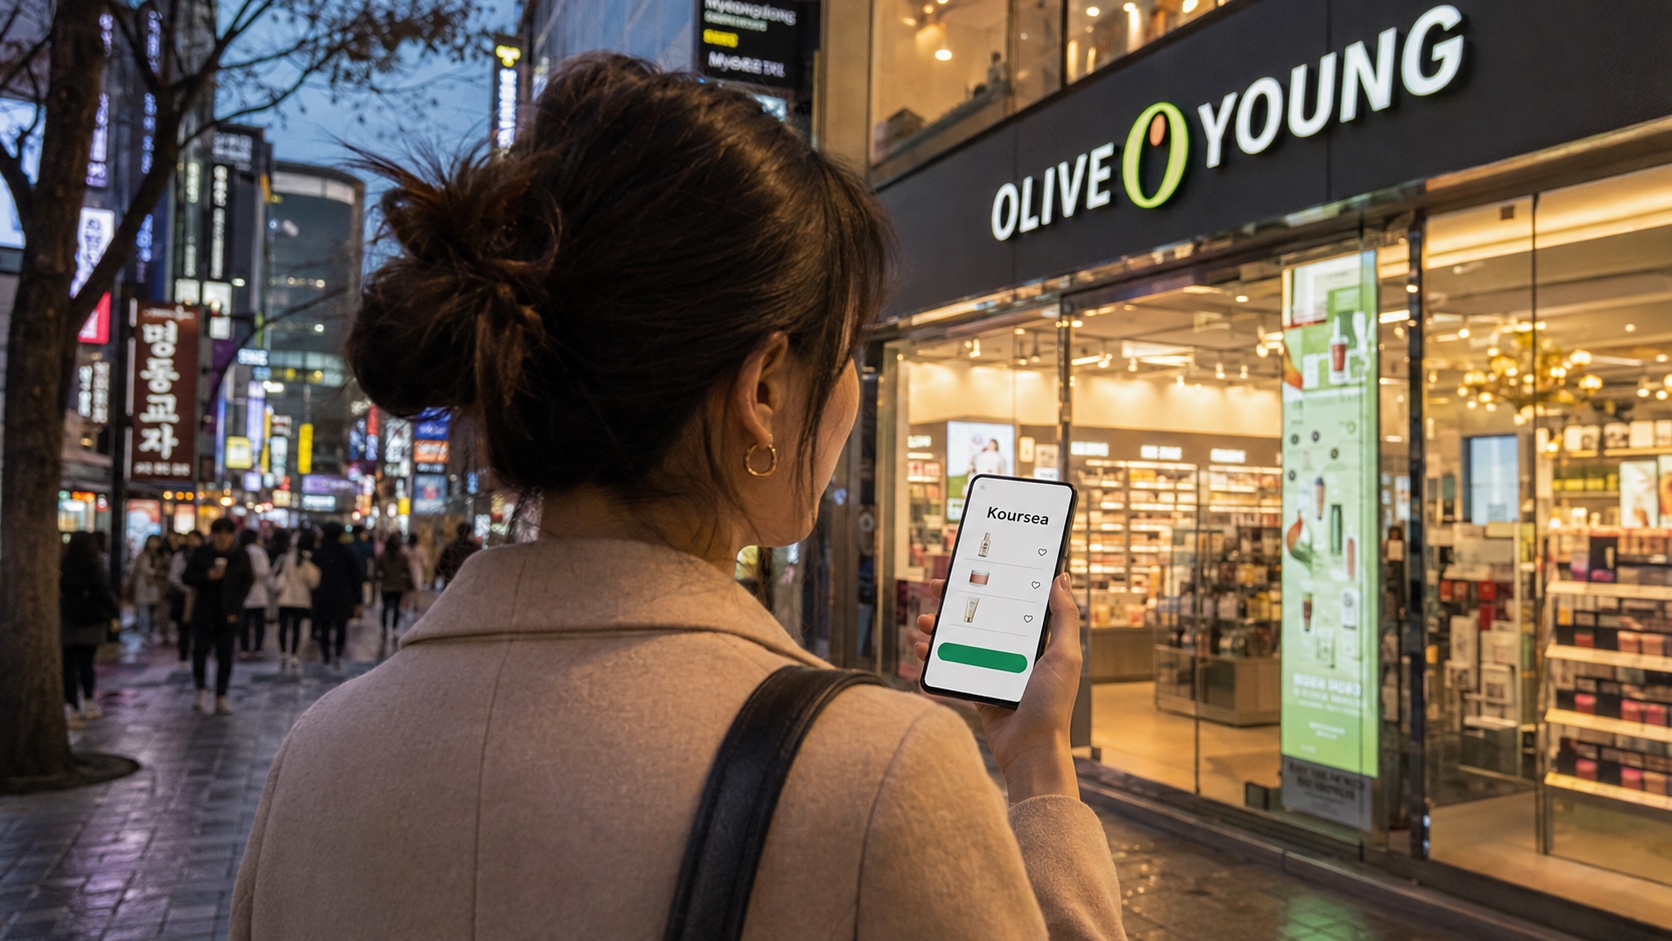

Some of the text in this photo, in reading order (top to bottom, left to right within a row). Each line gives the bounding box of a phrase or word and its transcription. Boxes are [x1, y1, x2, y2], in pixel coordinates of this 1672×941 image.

[991, 142, 1114, 241] OLIVE
[1197, 4, 1464, 169] YOUNG
[138, 319, 181, 460] 명동교자
[986, 506, 1050, 526] Koursea
